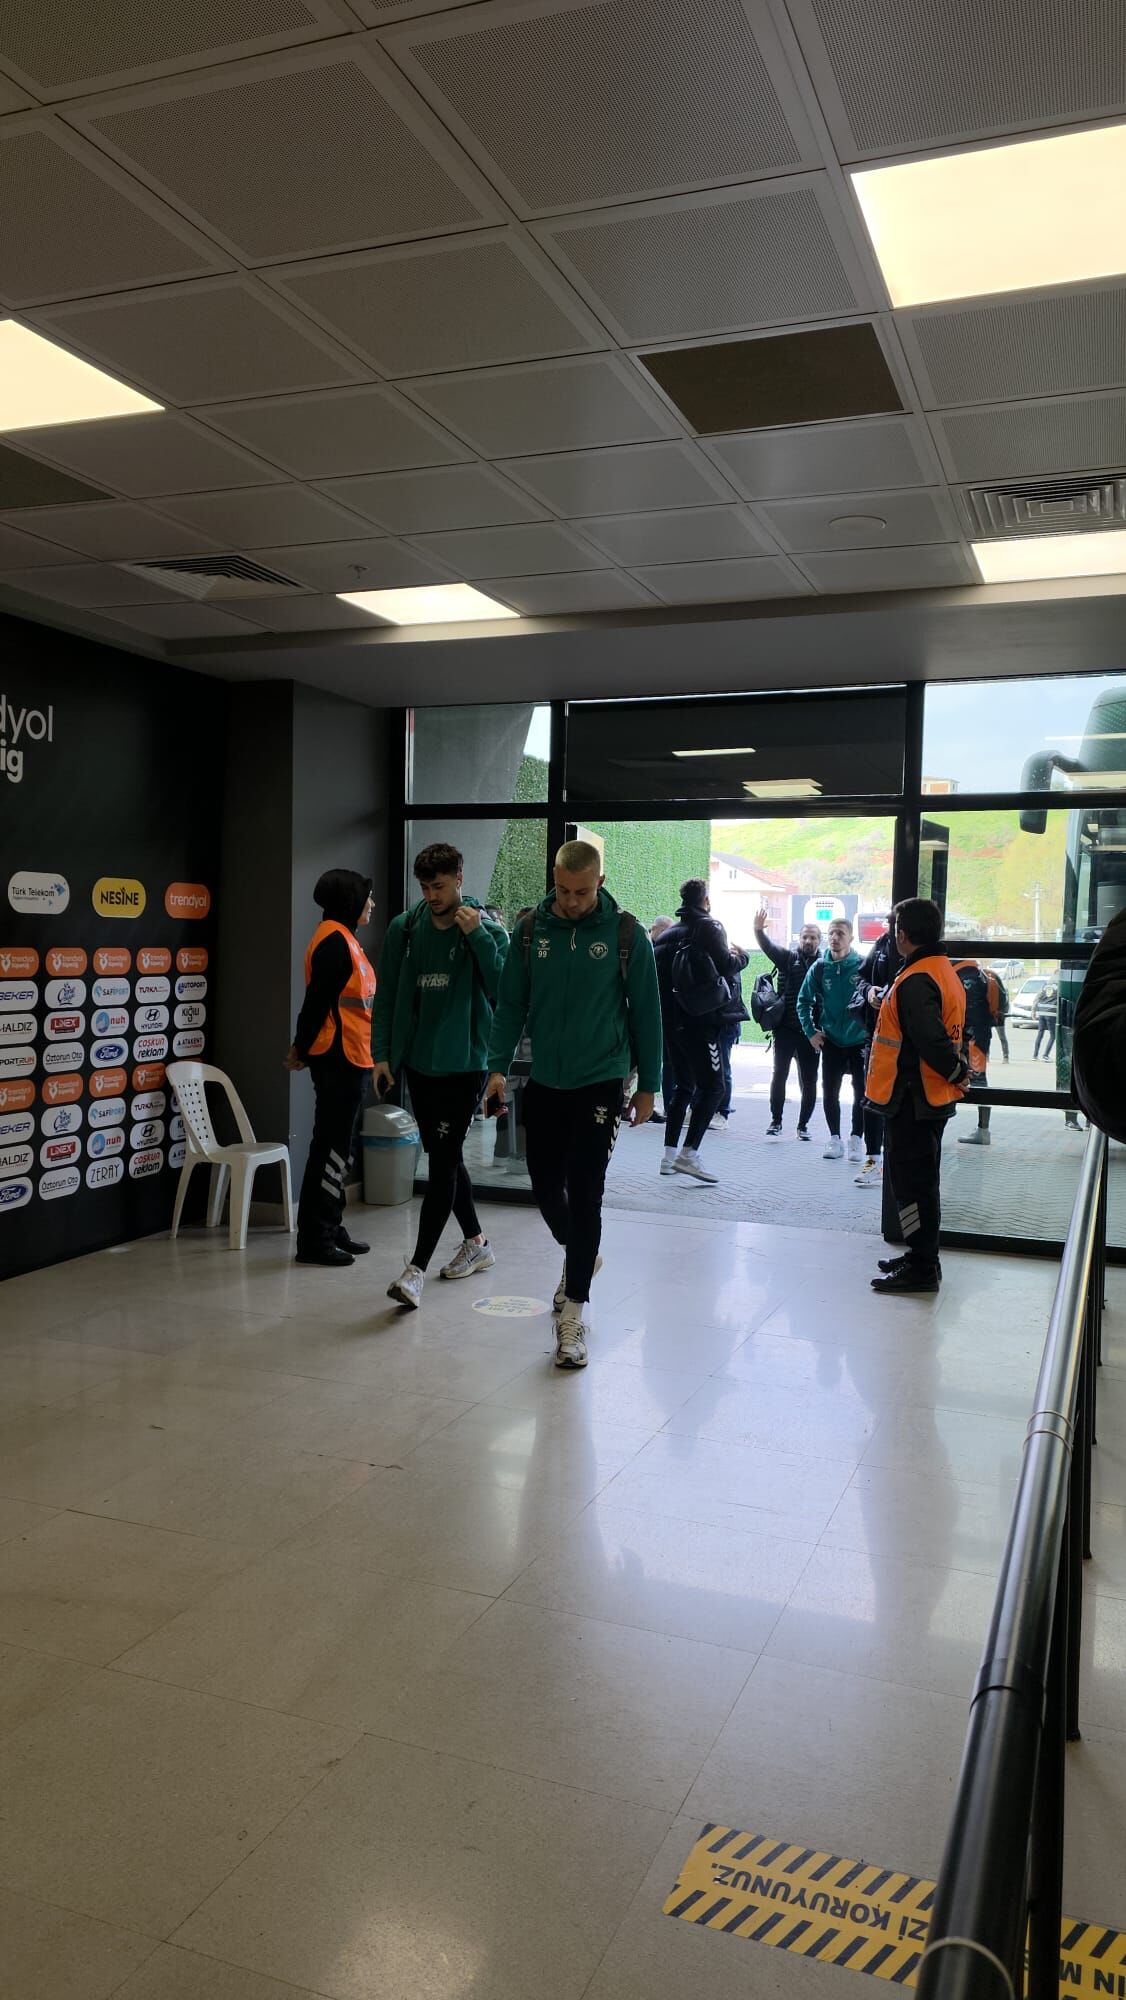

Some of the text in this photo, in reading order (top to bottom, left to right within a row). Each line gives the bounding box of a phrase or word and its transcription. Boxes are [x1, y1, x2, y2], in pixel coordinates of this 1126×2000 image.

[12, 886, 55, 897] Türk Telekom
[170, 892, 207, 909] trendyol
[538, 950, 548, 958] 99
[110, 1015, 126, 1025] nuh
[140, 1022, 163, 1030] HYUNDAI
[99, 1046, 121, 1058] Ford
[137, 1047, 164, 1059] reklam
[90, 1163, 120, 1183] ZERAY
[132, 1161, 160, 1176] reklam
[711, 1862, 892, 1932] KORUYUNUZ.
